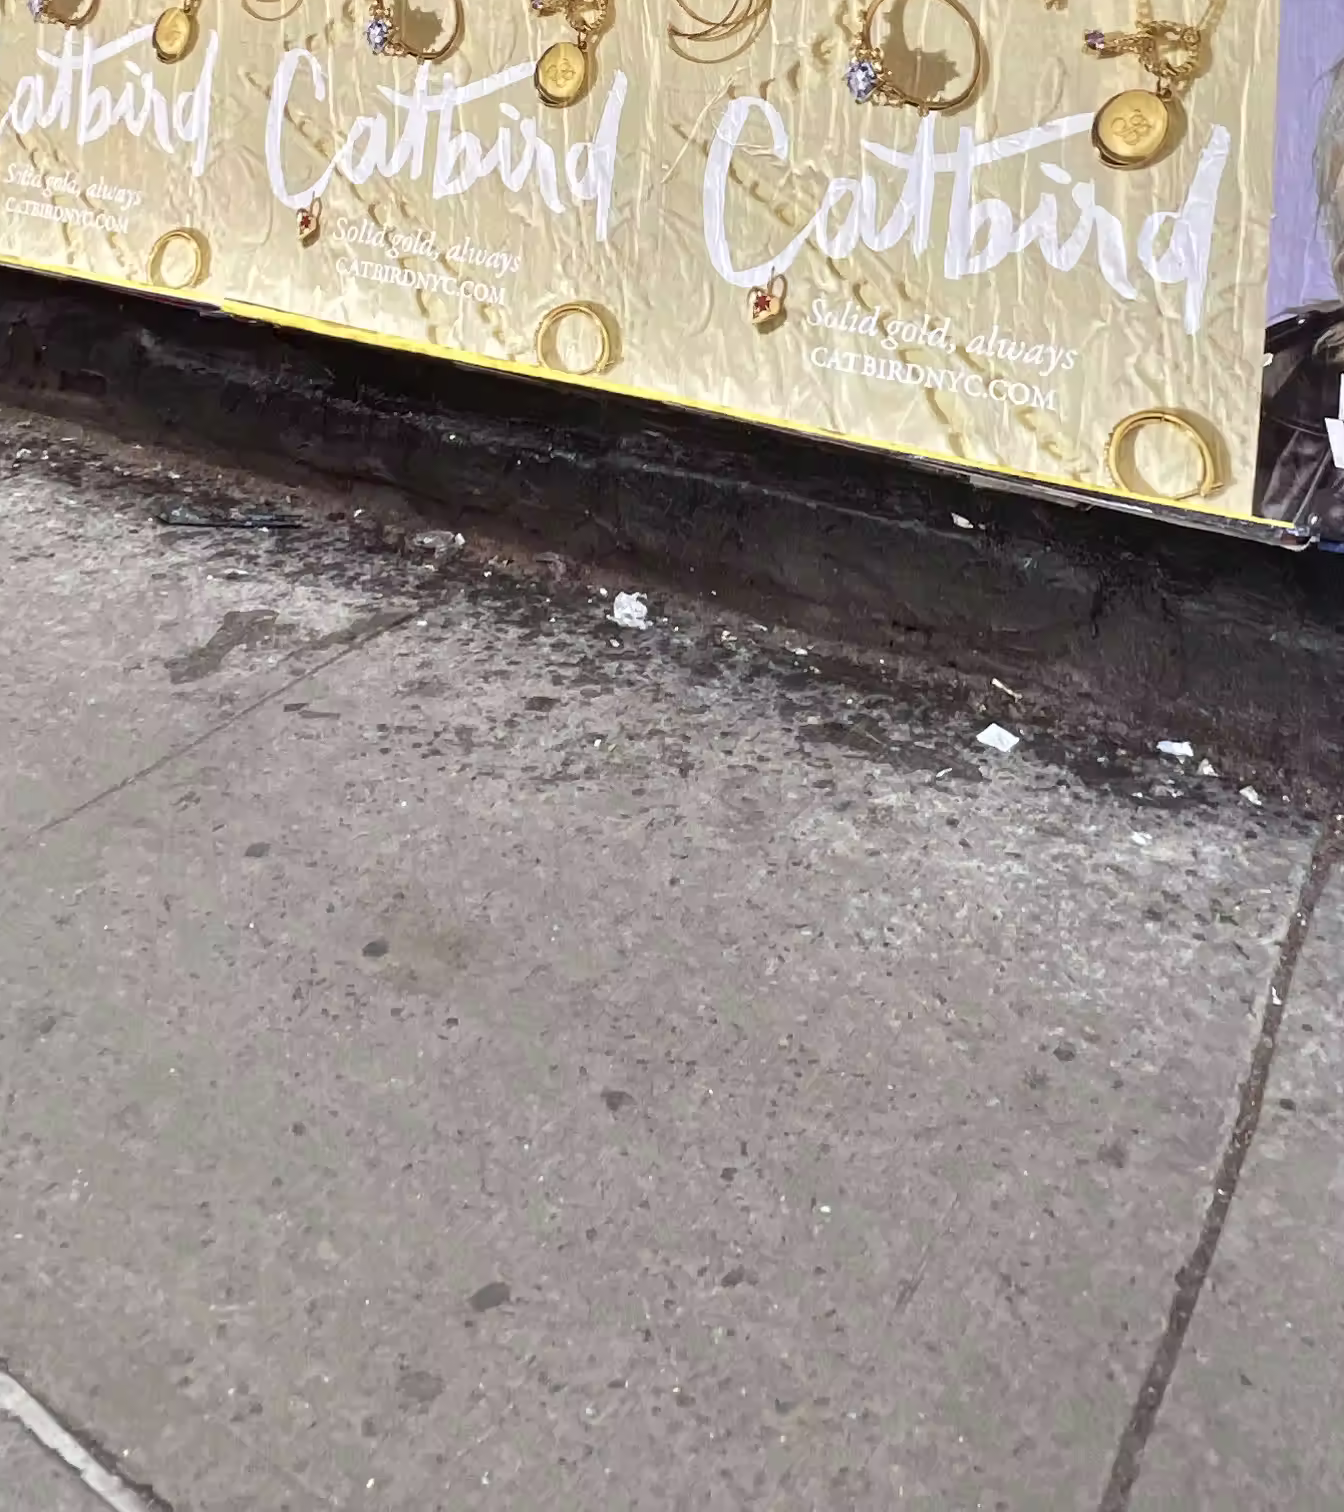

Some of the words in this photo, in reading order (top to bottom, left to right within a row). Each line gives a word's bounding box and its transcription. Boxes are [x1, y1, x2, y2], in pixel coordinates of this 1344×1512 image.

[264, 47, 628, 242] Catbird
[86, 176, 143, 211] always
[702, 95, 1231, 335] Catbird
[333, 217, 387, 249] Solid
[386, 228, 440, 261] gold,
[446, 236, 522, 279] always
[335, 256, 505, 305] CATBIRDNYC.COM
[807, 297, 881, 337] Solid
[880, 314, 957, 354] gold,
[965, 325, 1079, 377] always
[810, 346, 1056, 411] CATBIRDNYC.COM
